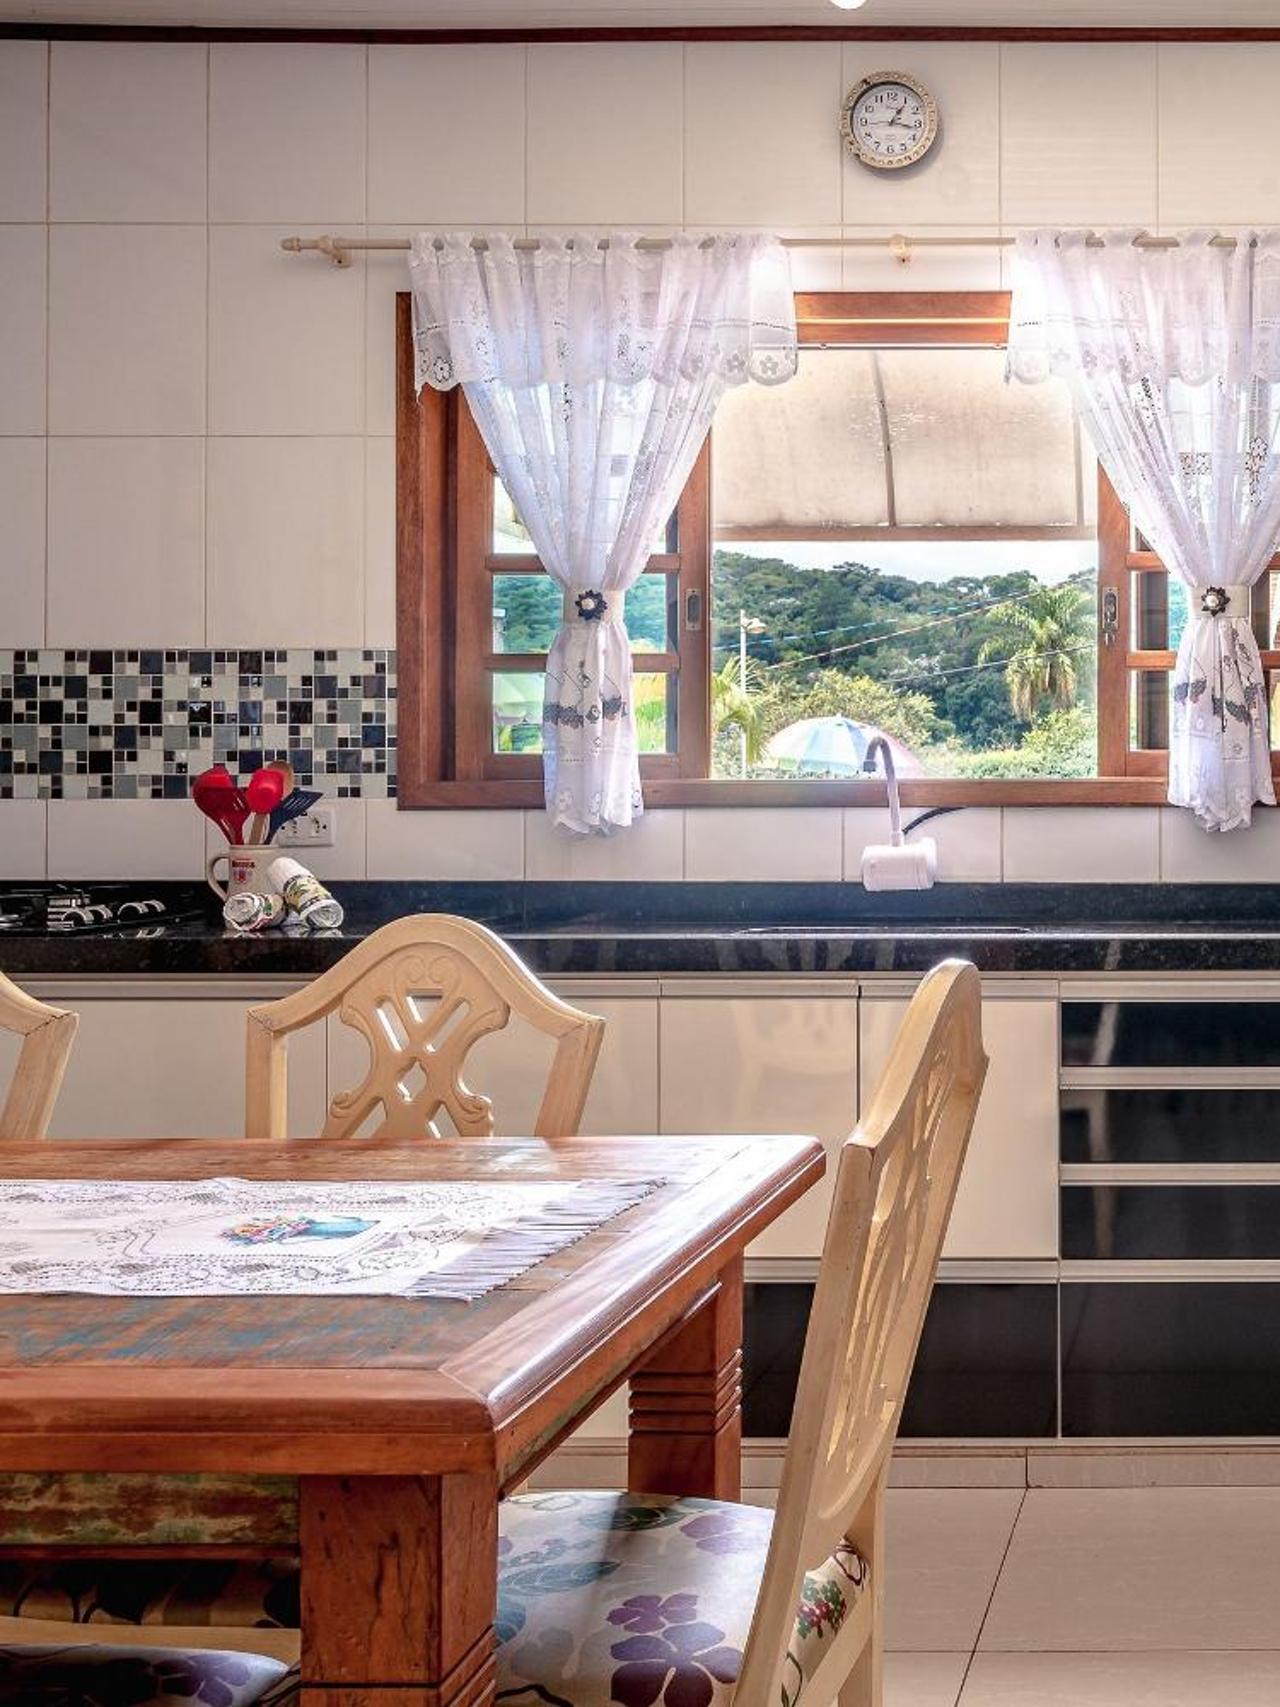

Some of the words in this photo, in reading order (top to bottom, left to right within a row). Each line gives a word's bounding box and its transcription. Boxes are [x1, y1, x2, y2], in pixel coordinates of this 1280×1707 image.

[875, 95, 883, 103] 11
[887, 92, 898, 101] 12
[865, 105, 874, 113] 10
[912, 105, 920, 115] 2
[860, 117, 868, 126] 9
[914, 119, 923, 128] 3
[864, 131, 872, 141] 8
[874, 141, 880, 151] 7
[887, 144, 895, 154] 6
[901, 143, 907, 151] 5
